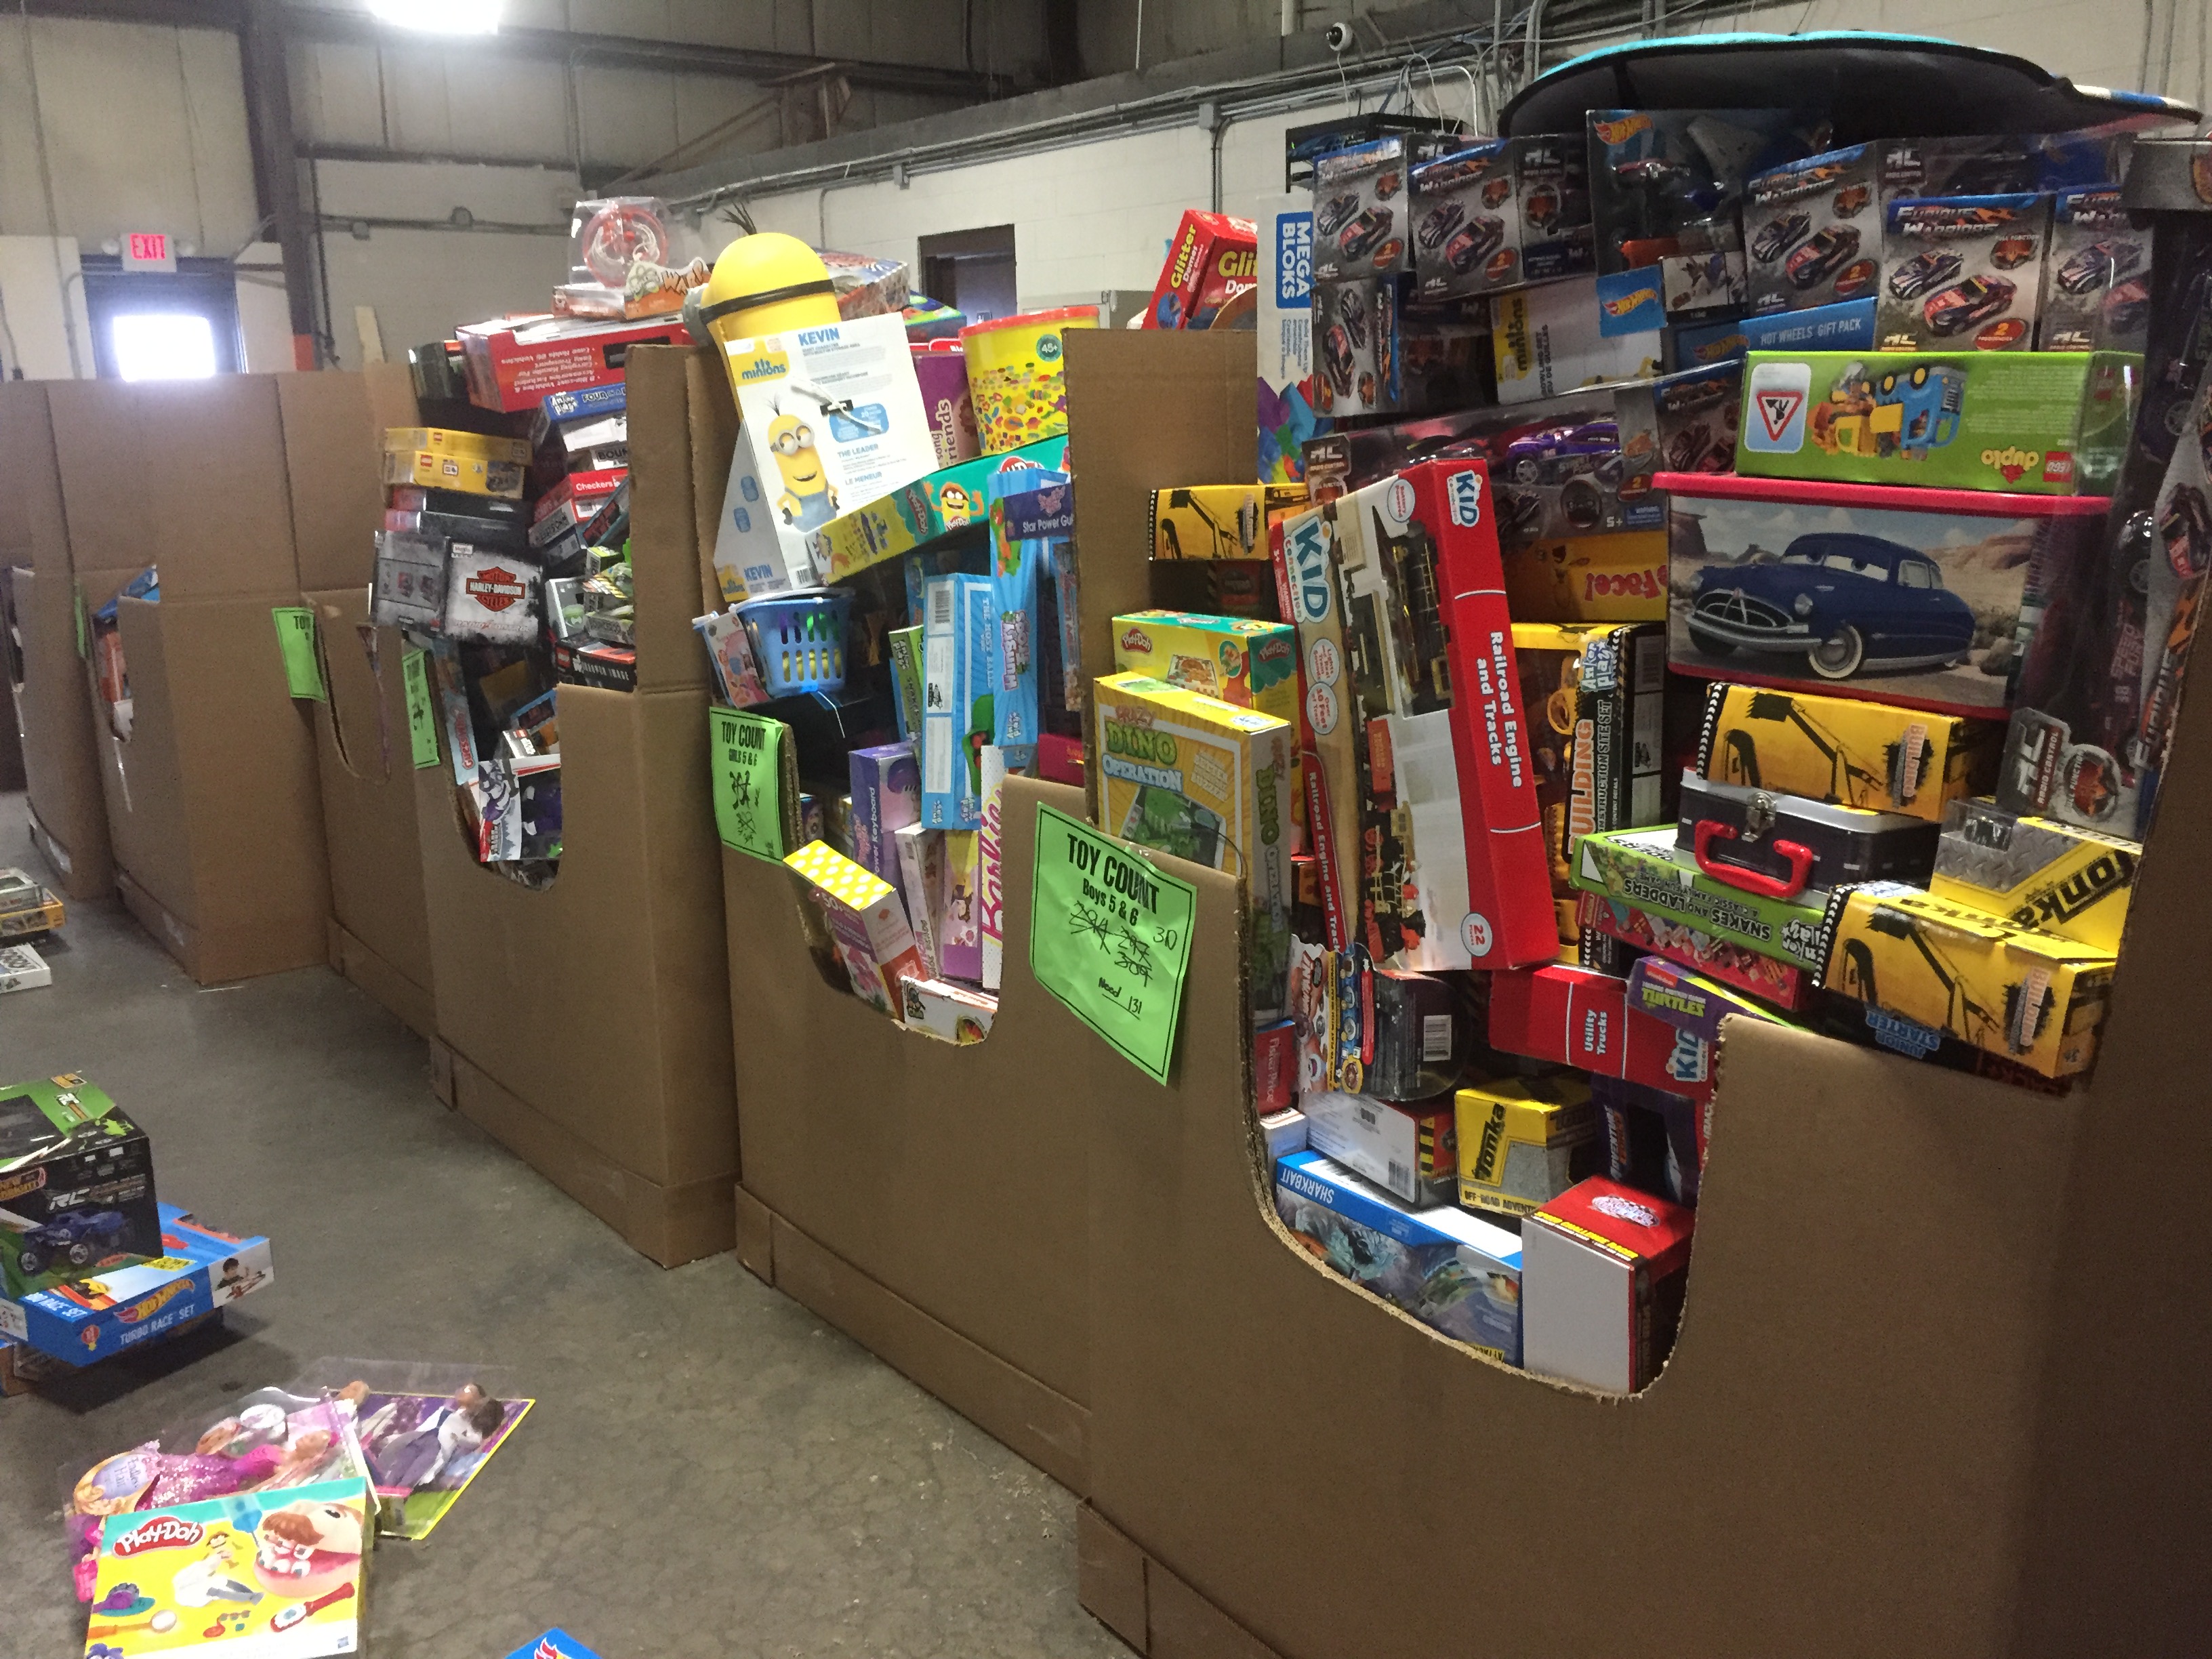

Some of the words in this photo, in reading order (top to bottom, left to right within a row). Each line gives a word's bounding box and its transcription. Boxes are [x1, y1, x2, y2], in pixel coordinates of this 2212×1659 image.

[130, 232, 166, 261] EXIT
[1171, 224, 1196, 288] Glitter
[1281, 222, 1295, 300] BLOKS
[1295, 222, 1311, 298] MEGA
[1182, 245, 1198, 283] Domes
[1218, 251, 1257, 278] Glit
[798, 327, 840, 347] KEVIN
[1761, 330, 1779, 345] HOT
[1779, 325, 1813, 344] WHEELS
[1818, 323, 1837, 337] GIFT
[1838, 318, 1862, 332] PACK
[741, 359, 786, 380] minions
[1981, 447, 2039, 469] duplo
[2046, 462, 2072, 474] LEGO
[575, 479, 613, 491] Checkers
[1455, 473, 1480, 525] KID
[1023, 518, 1036, 533] Star
[1038, 518, 1060, 531] Power
[1605, 516, 1624, 528] 5+
[743, 564, 773, 579] KEVIN
[1294, 520, 1329, 618] KID
[1584, 569, 1662, 602] Face!
[469, 581, 523, 596] HARLEY-DAVIDSON
[1002, 621, 1018, 690] Hungry
[1122, 632, 1152, 651] Play-Doh
[1477, 659, 1494, 695] and
[1581, 641, 1600, 691] Anker
[1597, 647, 1616, 689] play
[1490, 631, 1514, 715] Railroad
[1504, 720, 1523, 788] Engine
[1598, 701, 1613, 724] SET
[721, 720, 738, 743] TOY
[739, 723, 766, 752] COUNT
[1105, 721, 1178, 766] DINO
[1484, 700, 1502, 766] Tracks
[1597, 724, 1611, 753] SITE
[741, 750, 747, 764] 5
[747, 751, 754, 766] &
[2041, 731, 2058, 777] CONTROL
[1103, 754, 1183, 794] OPERATION
[1256, 766, 1280, 845] DINO
[1597, 754, 1610, 833] ONSTRUCTION
[2037, 779, 2050, 808] RADIO
[867, 787, 876, 843] Keyboard
[1308, 771, 1325, 831] Railroad
[1317, 834, 1330, 882] Engine
[1324, 885, 1334, 912] and
[1067, 833, 1101, 876] TOY
[1103, 855, 1160, 915] COUNT
[1637, 872, 1659, 886] GAME
[1661, 878, 1681, 893] FUN
[2009, 848, 2134, 926] Tonka
[1082, 878, 1107, 908] Boys
[1108, 897, 1116, 914] 5
[1118, 901, 1128, 919] &
[1129, 909, 1138, 926] 6
[1623, 879, 1692, 912] LADDERS
[1681, 886, 1711, 905] FAMILY
[1685, 899, 1709, 916] AND
[1711, 896, 1750, 915] CLASSIC
[1472, 924, 1485, 946] 22
[1711, 908, 1771, 940] SNAKES
[1099, 977, 1122, 998] Need
[1128, 996, 1143, 1015] 131
[1641, 989, 1705, 1018] TURTLES
[1585, 1009, 1597, 1052] Utility
[1596, 1011, 1608, 1055] Trucks
[1866, 1009, 1941, 1051] STARTER
[1472, 1102, 1507, 1181] Tonka
[1279, 1167, 1335, 1205] SHARKBAIT
[1464, 1190, 1500, 1208] OFF-ROAD
[1502, 1198, 1537, 1214] ADVENT
[120, 1323, 150, 1346] TURBO
[150, 1315, 173, 1338] RACE
[178, 1304, 195, 1319] SET
[115, 1467, 127, 1488] Hair
[118, 1521, 203, 1553] Play-Doh
